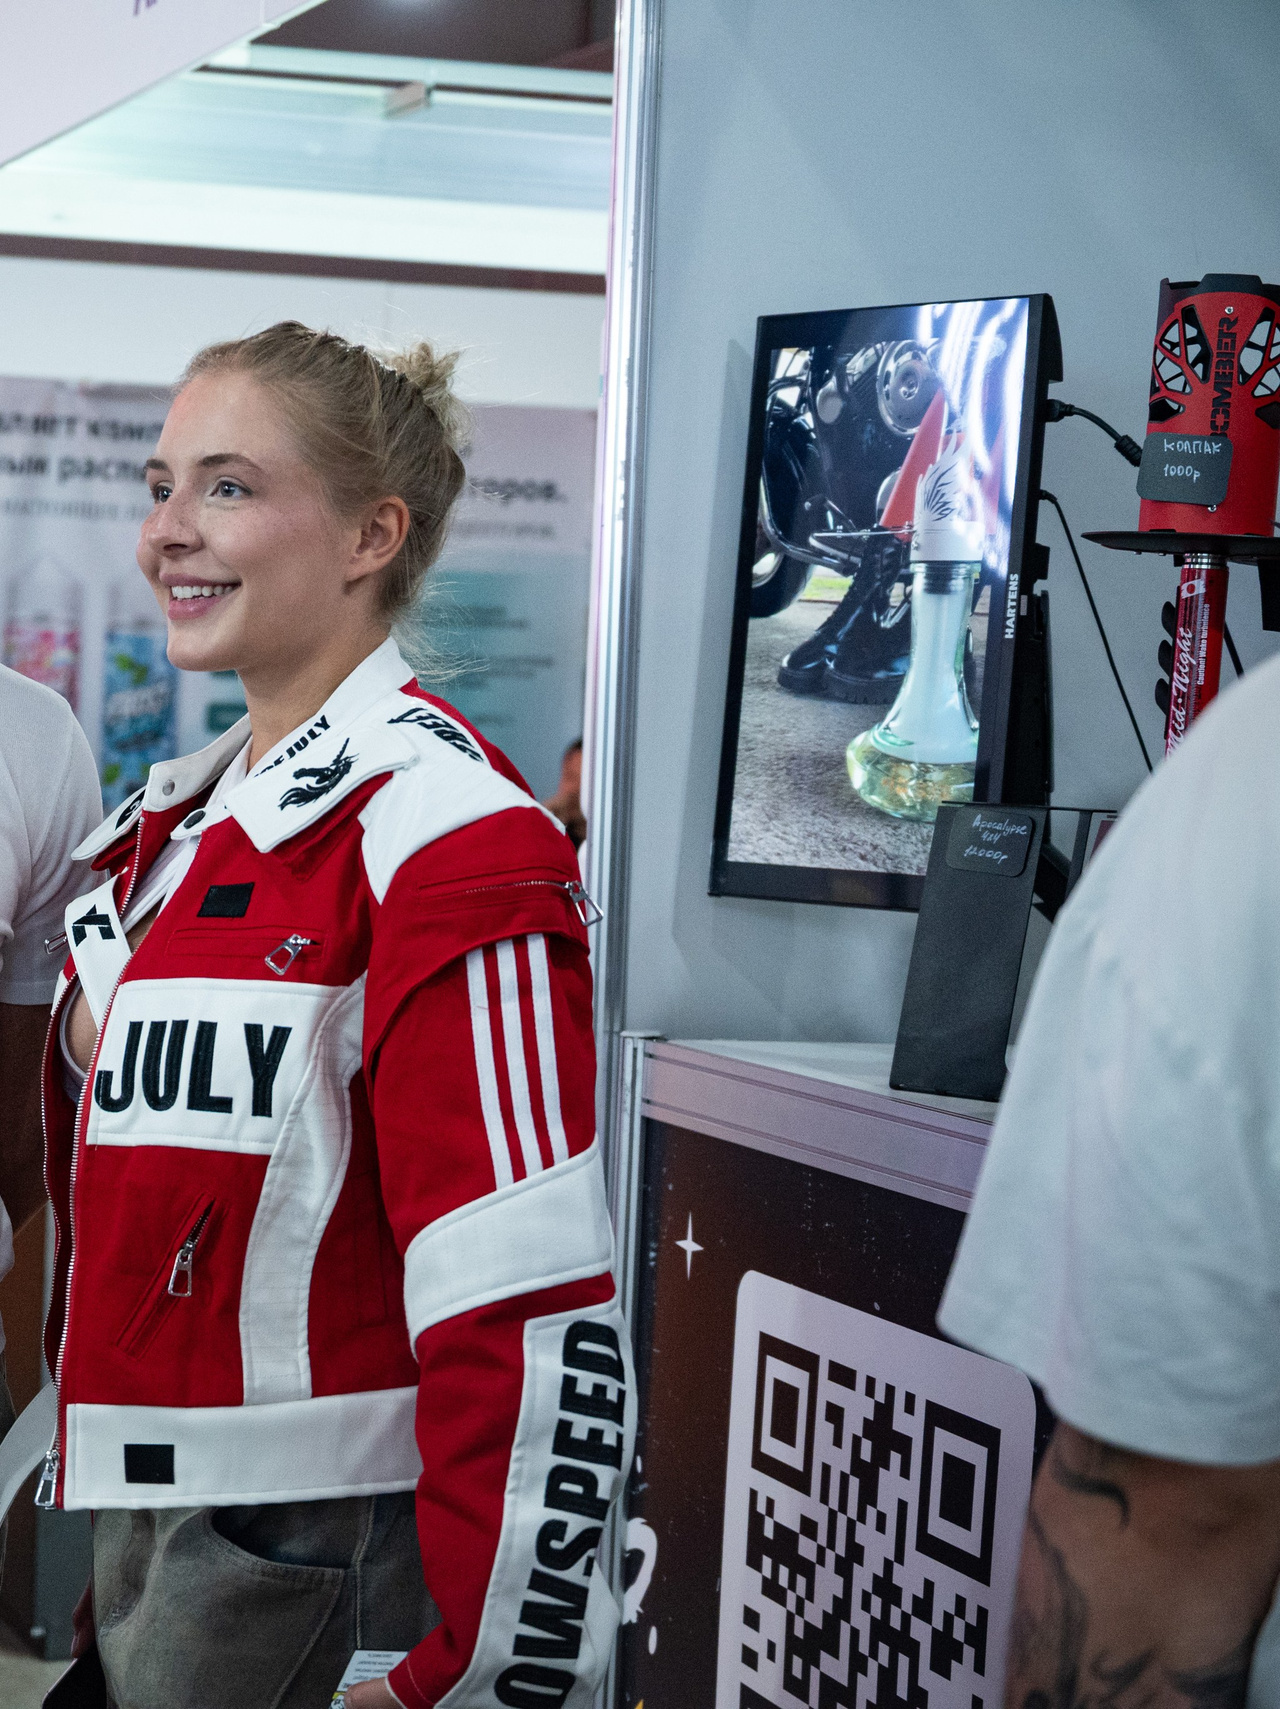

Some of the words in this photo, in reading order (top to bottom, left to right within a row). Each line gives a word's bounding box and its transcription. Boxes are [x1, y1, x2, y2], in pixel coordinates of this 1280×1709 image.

[1210, 316, 1238, 437] OMBER
[1004, 573, 1019, 639] HARTENS
[285, 714, 331, 760] JULY
[972, 813, 1027, 837] Apocalypse
[94, 1018, 293, 1118] JULY
